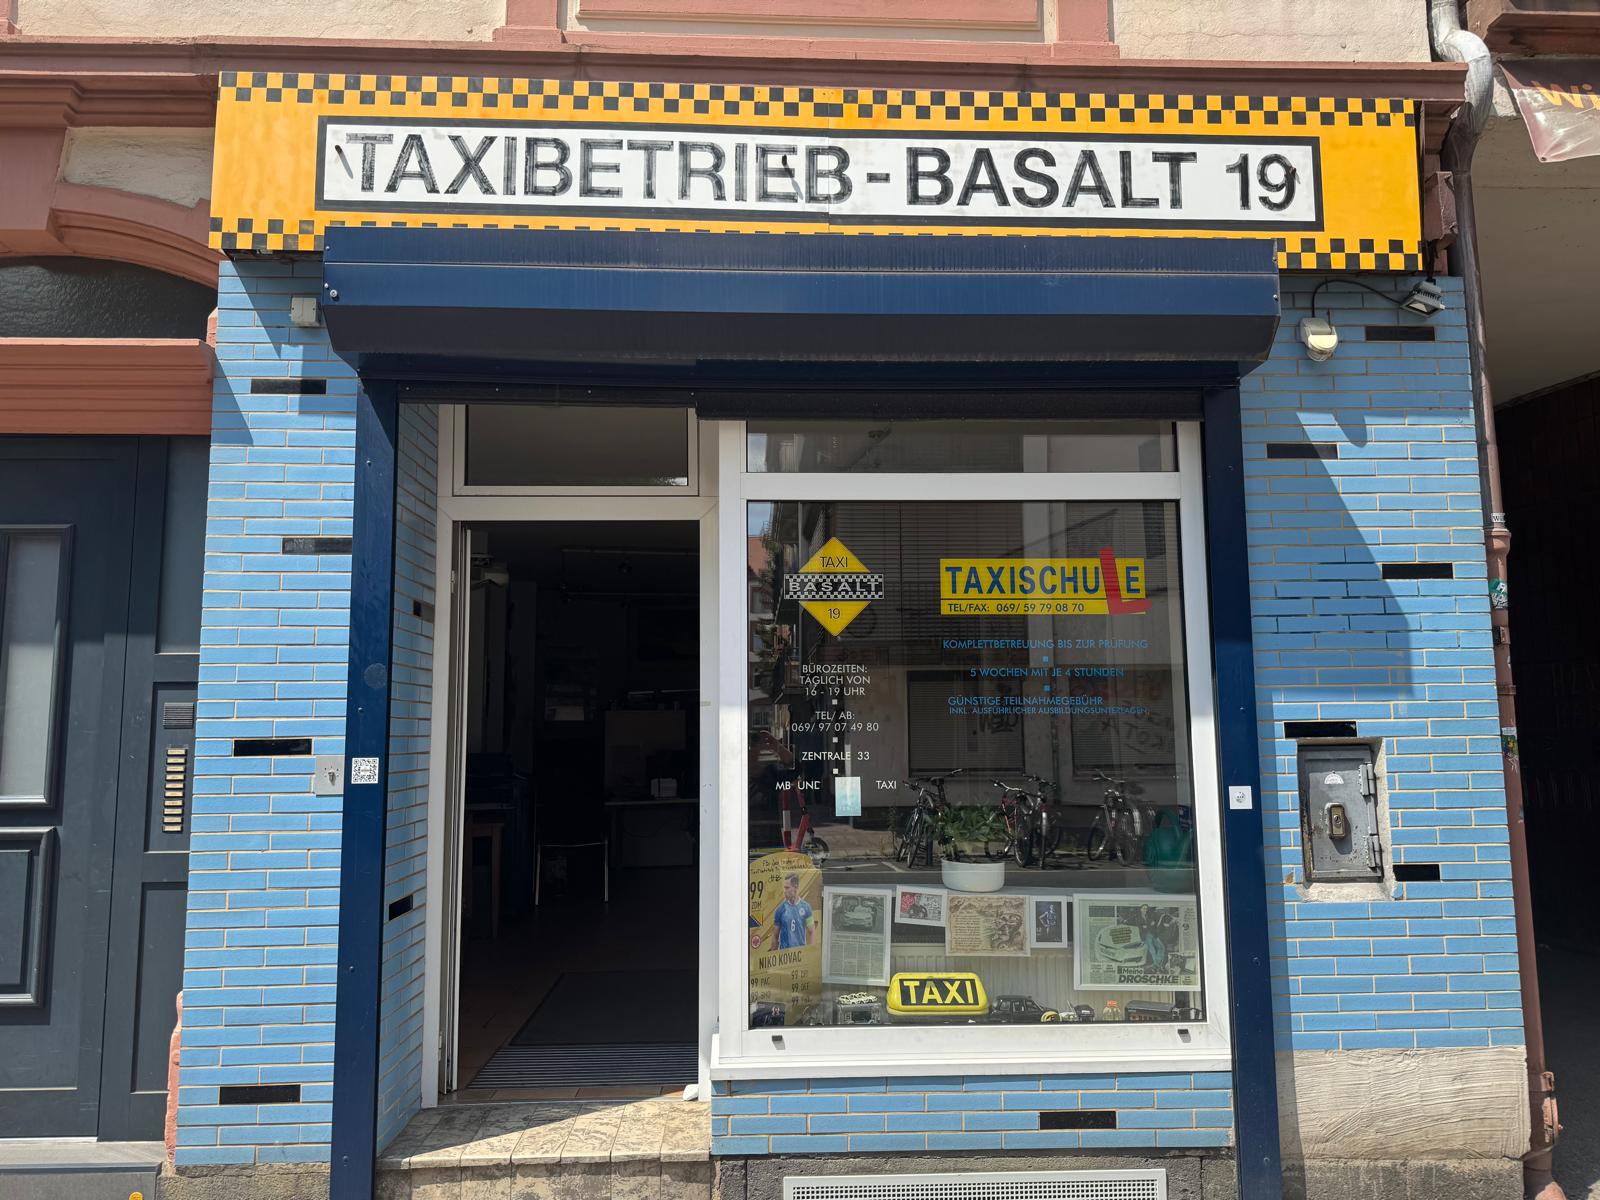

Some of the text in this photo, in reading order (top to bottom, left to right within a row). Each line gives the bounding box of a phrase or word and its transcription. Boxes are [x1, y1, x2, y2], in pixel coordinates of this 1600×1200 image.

[1225, 152, 1300, 212] 19
[820, 556, 848, 568] TAXI
[789, 581, 879, 592] BASALT
[944, 547, 1151, 616] TAXISCHULE
[828, 607, 841, 620] 19
[948, 603, 1085, 613] TEL/FAX: 069/ 59 79 08 70
[942, 639, 1055, 649] KOMPLETTBETREUUNG
[1058, 639, 1073, 649] BIS
[1075, 639, 1096, 649] ZUR
[802, 662, 868, 673] BÜROZEITEN:
[969, 668, 1125, 677] 5 WOCHEN MIT JE 4 STUNDEN
[799, 674, 871, 685] TÄGLICH VON
[805, 686, 817, 696] 16
[828, 687, 840, 696] 19
[843, 687, 866, 696] UHR
[947, 694, 1104, 706] GÜNSTIGE TEILNAHMEGEBÜHR
[971, 705, 1036, 715] AUSFÜHRLICHER
[815, 711, 856, 721] TEL/ AB:
[791, 722, 879, 733] 069/ 97 07 49 80
[801, 751, 870, 761] ZENTRALE 33
[775, 780, 791, 790] MB
[875, 780, 897, 789] TAXI
[750, 880, 764, 900] 99
[790, 919, 796, 932] 6
[759, 950, 802, 969] NIKO KOVAC
[1122, 967, 1144, 975] Meine
[1118, 974, 1179, 984] DROSCHKE
[903, 980, 974, 1004] TAXI
